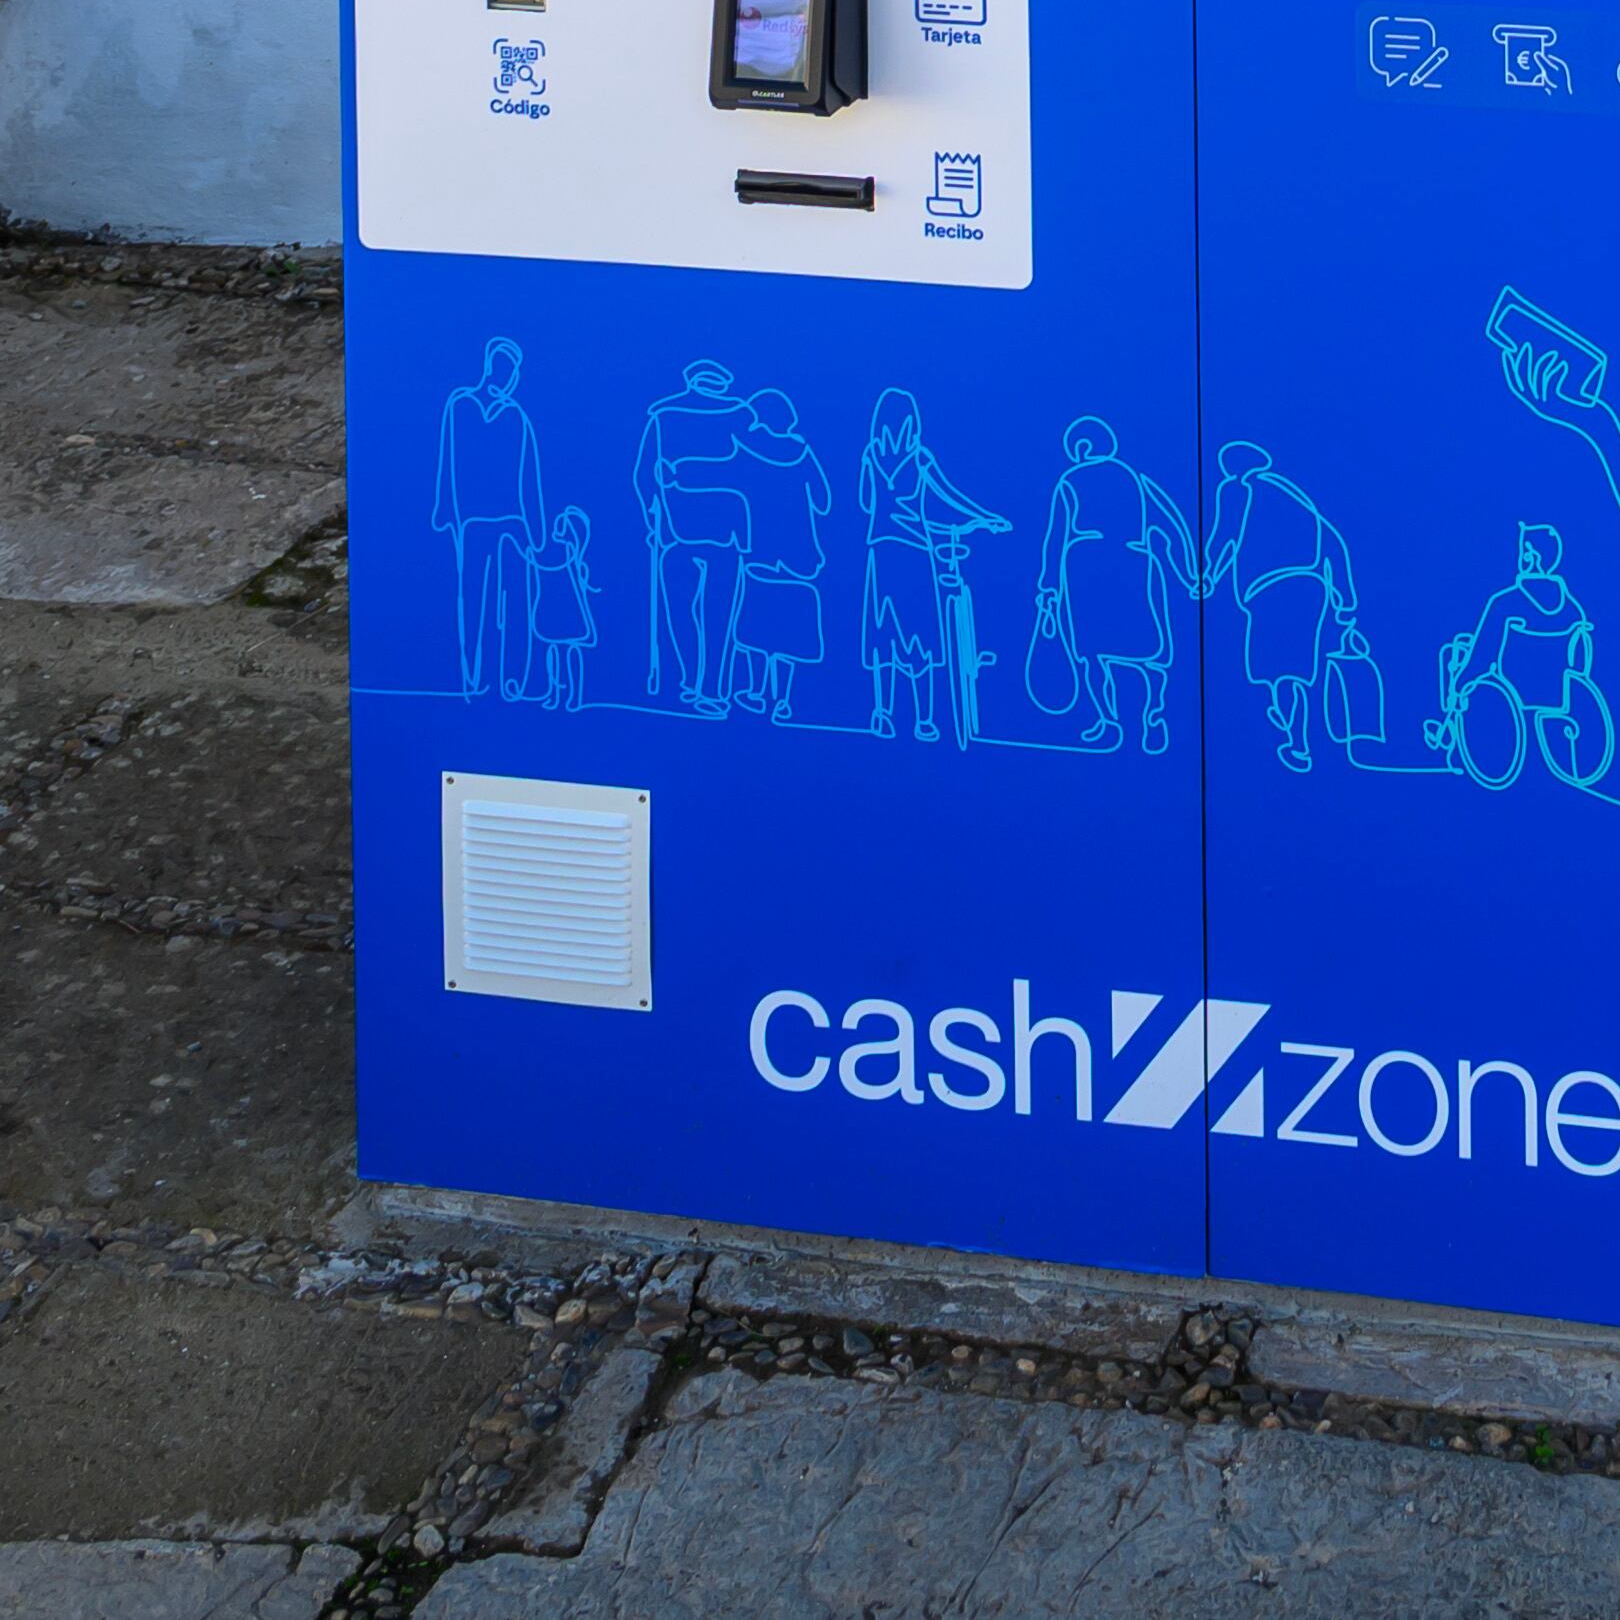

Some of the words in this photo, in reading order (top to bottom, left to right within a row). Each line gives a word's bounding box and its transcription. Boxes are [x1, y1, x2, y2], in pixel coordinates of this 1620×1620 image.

[920, 26, 982, 47] Tarjeta
[490, 98, 551, 120] Código
[924, 222, 984, 241] Recibo
[749, 978, 1093, 1122] cash
